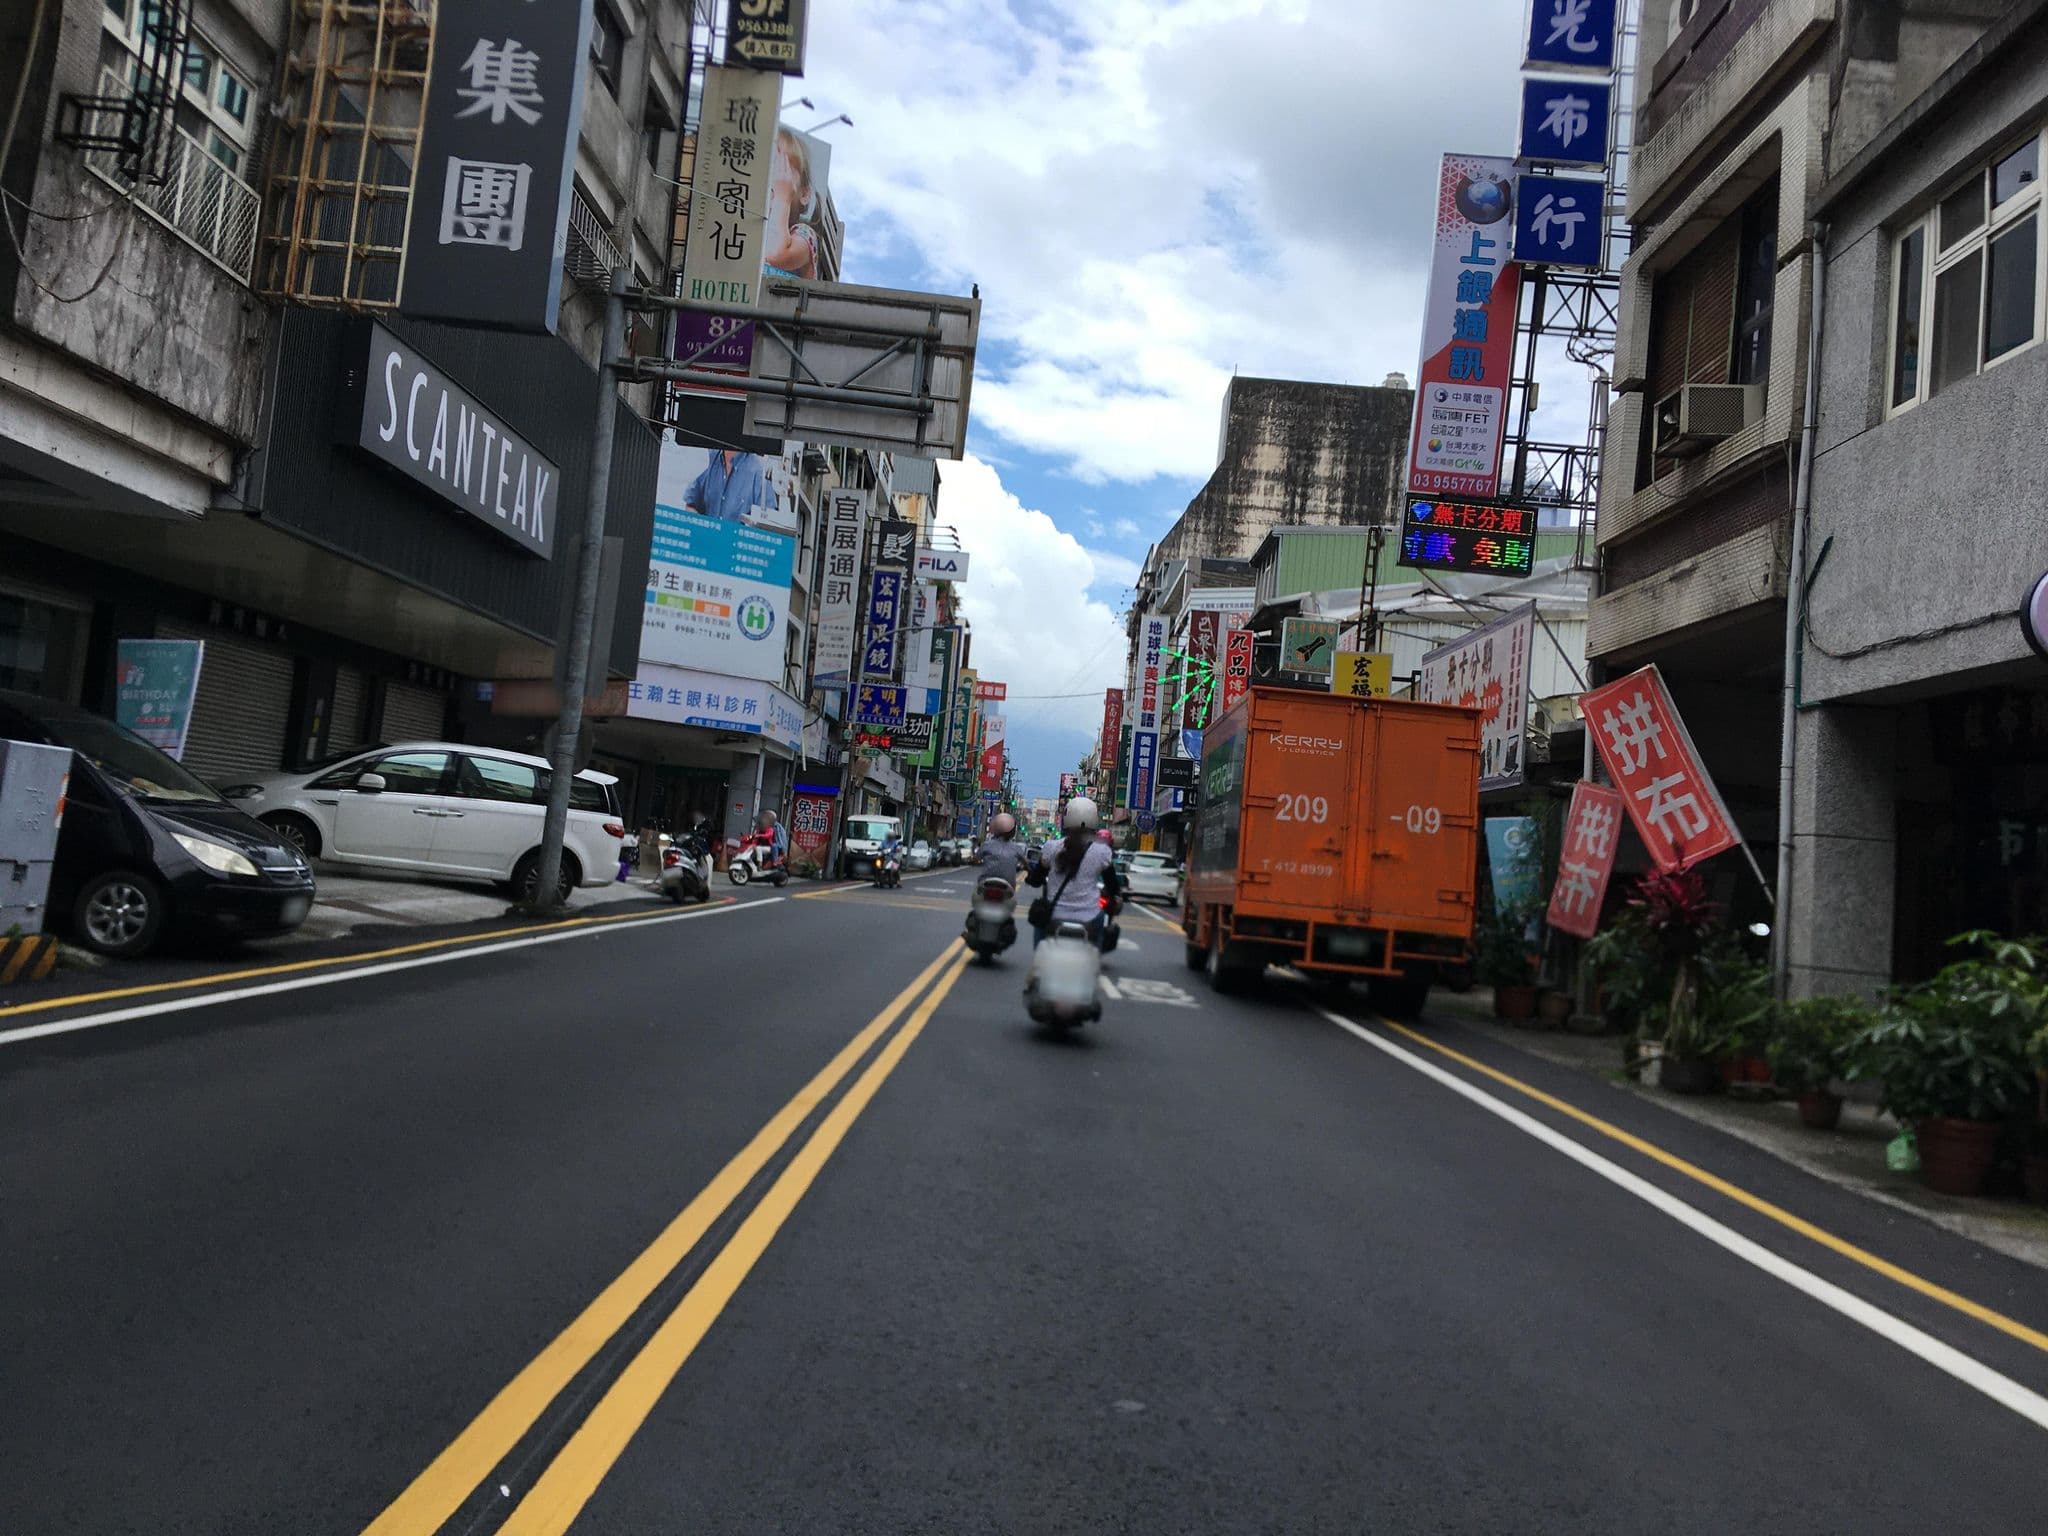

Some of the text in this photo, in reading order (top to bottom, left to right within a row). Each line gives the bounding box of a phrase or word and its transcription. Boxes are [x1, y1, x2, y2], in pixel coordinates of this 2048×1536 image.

[691, 278, 750, 304] HOTEL
[1448, 230, 1496, 381] 上銀通訊
[1452, 391, 1493, 404] 中華電信
[1431, 424, 1463, 437] 台灣之星
[1471, 427, 1487, 435] STAR
[1464, 412, 1490, 424] FET
[379, 351, 549, 542] SCANTEAK
[1446, 441, 1487, 453] 台灣大哥大
[1413, 472, 1492, 493] 03 9557767
[1432, 501, 1523, 533] 無卡分期
[826, 496, 860, 605] 宜展通訊
[918, 556, 958, 573] FILA
[868, 576, 896, 669] 宏明眼鏡
[1140, 620, 1163, 728] 地球村美日韓語
[1351, 656, 1373, 697] 宏福
[627, 682, 758, 716] 王瀚生眼科診所
[1270, 733, 1342, 750] KERRY
[1602, 692, 1710, 845] 拼布
[1275, 793, 1328, 823] 209
